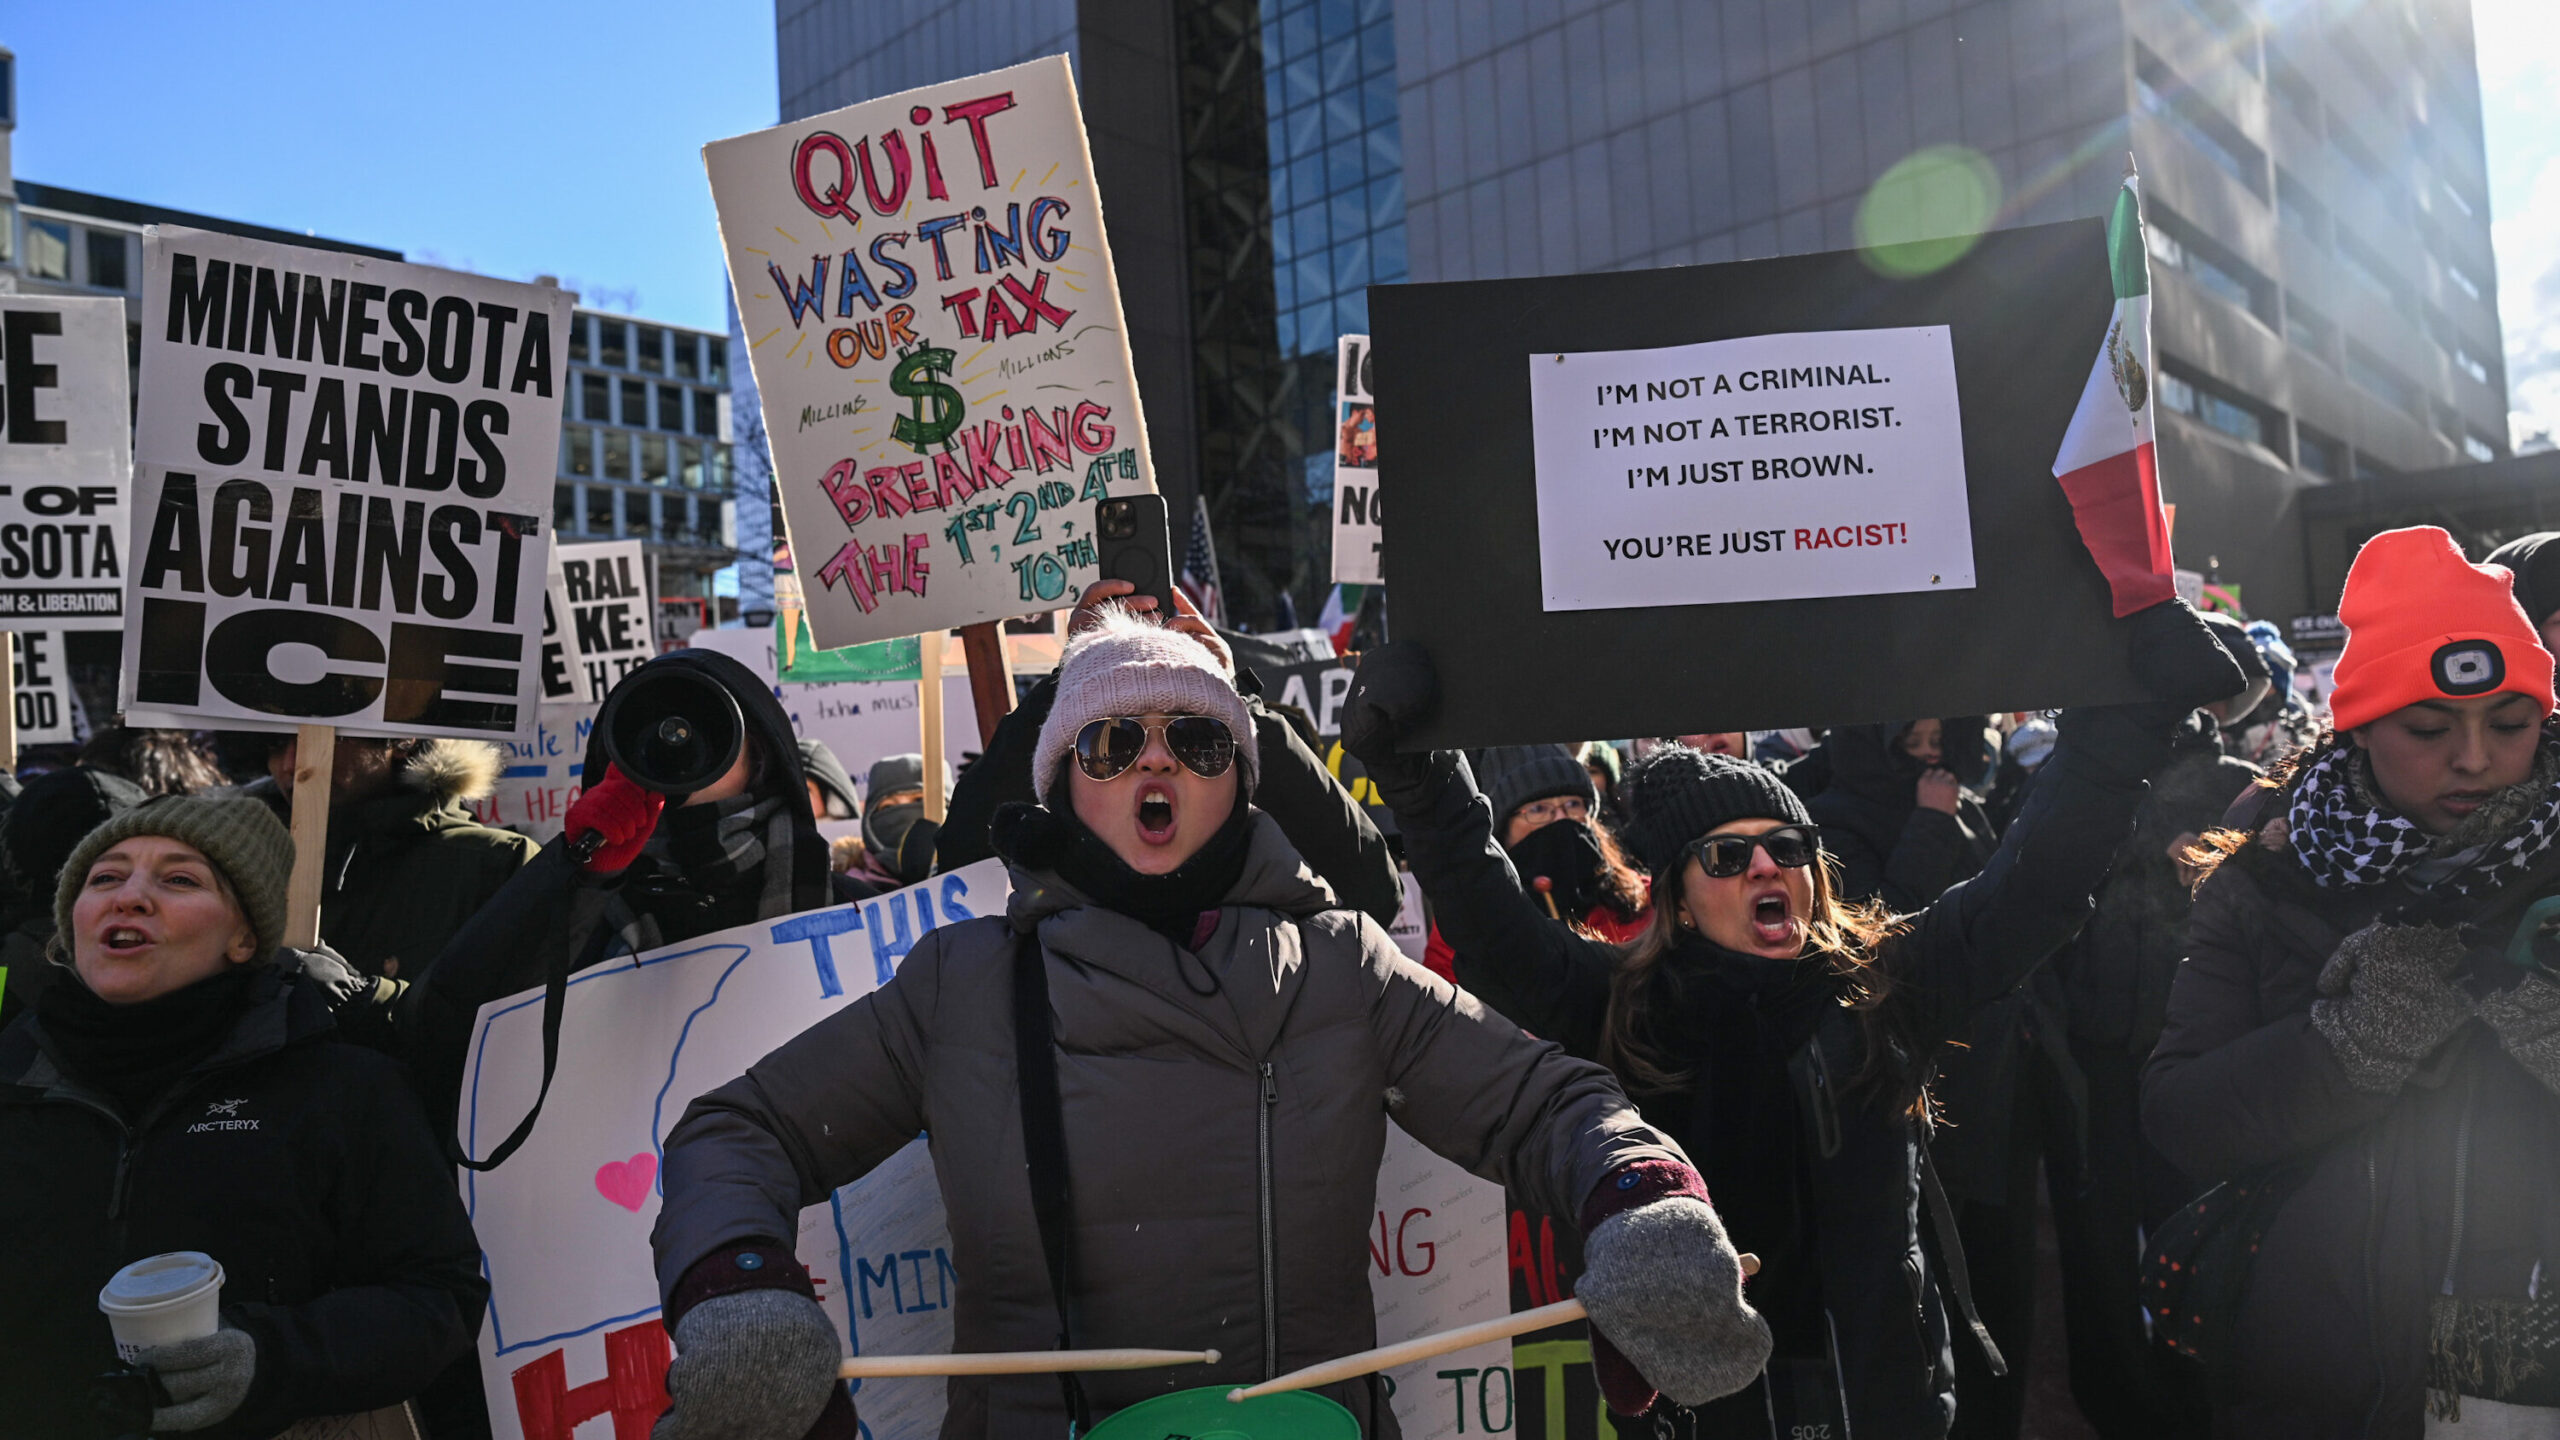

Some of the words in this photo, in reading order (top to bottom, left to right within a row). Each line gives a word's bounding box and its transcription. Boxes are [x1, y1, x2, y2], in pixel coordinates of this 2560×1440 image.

[166, 253, 553, 398] MINNESOTA
[826, 304, 919, 369] OUR
[941, 269, 1077, 342] TAX
[0, 310, 67, 444] E
[998, 340, 1075, 379] MILLIONS
[1597, 384, 1638, 406] I'M
[1647, 376, 1705, 401] NOT
[1713, 374, 1732, 394] A
[1739, 364, 1890, 391] CRIMINAL.
[197, 362, 509, 498] STANDS
[799, 395, 868, 433] MILLIONS
[1594, 426, 1634, 448] I'M
[1644, 419, 1702, 444] NOT
[1710, 418, 1729, 438] A
[1734, 406, 1901, 436] TERRORIST.
[1628, 466, 1669, 489] I'M
[1678, 461, 1743, 486] JUST
[1752, 453, 1873, 480] BROWN.
[23, 485, 117, 516] OF
[0, 523, 121, 579] SOTA
[140, 471, 539, 625] AGAINST
[1603, 534, 1711, 560] YOU'RE
[1719, 530, 1786, 555] JUST
[1794, 522, 1908, 551] RACIST!
[564, 556, 640, 603] RAL
[815, 533, 931, 614] THE
[17, 595, 36, 612] &
[37, 593, 118, 612] LIBERATION
[574, 603, 645, 655] KE:
[136, 597, 524, 732] ICE
[583, 661, 609, 702] H
[1436, 1366, 1514, 1434] TO
